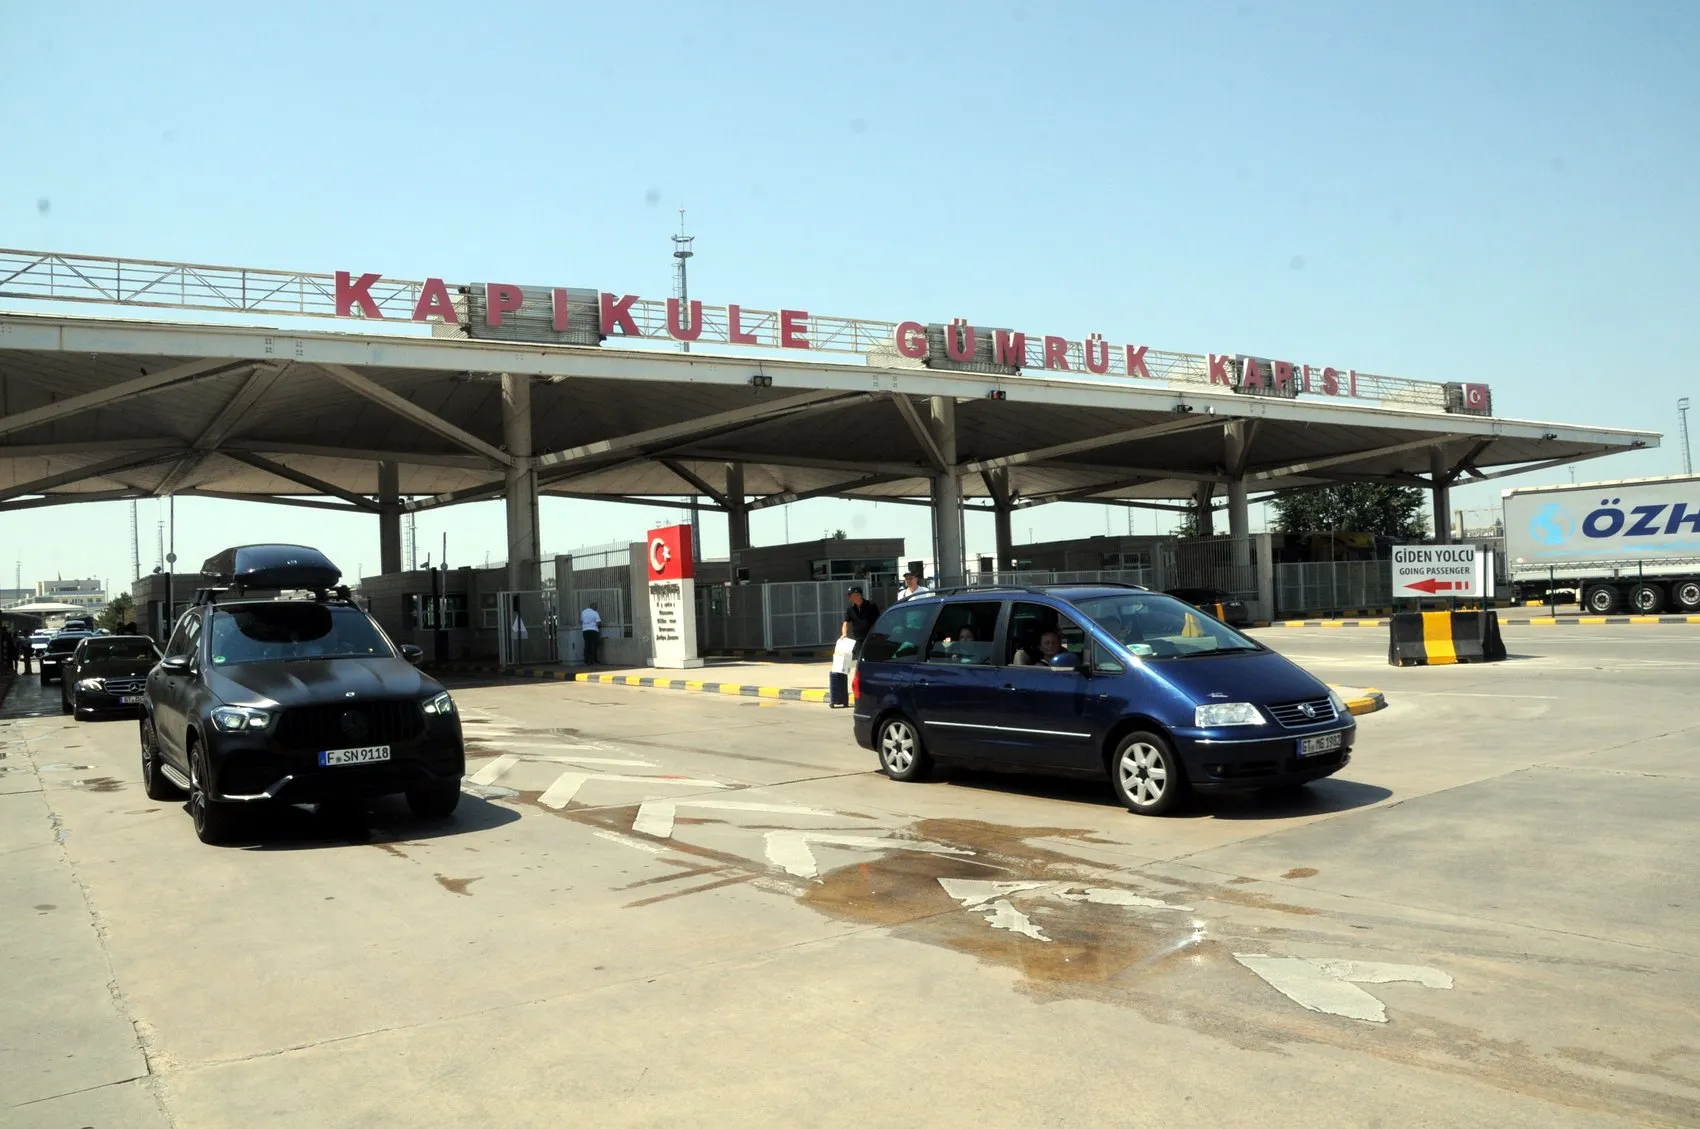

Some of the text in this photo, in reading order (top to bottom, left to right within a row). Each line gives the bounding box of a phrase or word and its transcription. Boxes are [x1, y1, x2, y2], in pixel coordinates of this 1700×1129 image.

[334, 270, 1357, 397] KAPIKULE GÜMRÜK KAPISI
[1394, 547, 1474, 563] GİDEN YOLCU
[1399, 566, 1470, 575] GOING PASSENGER
[360, 747, 389, 761] 9118
